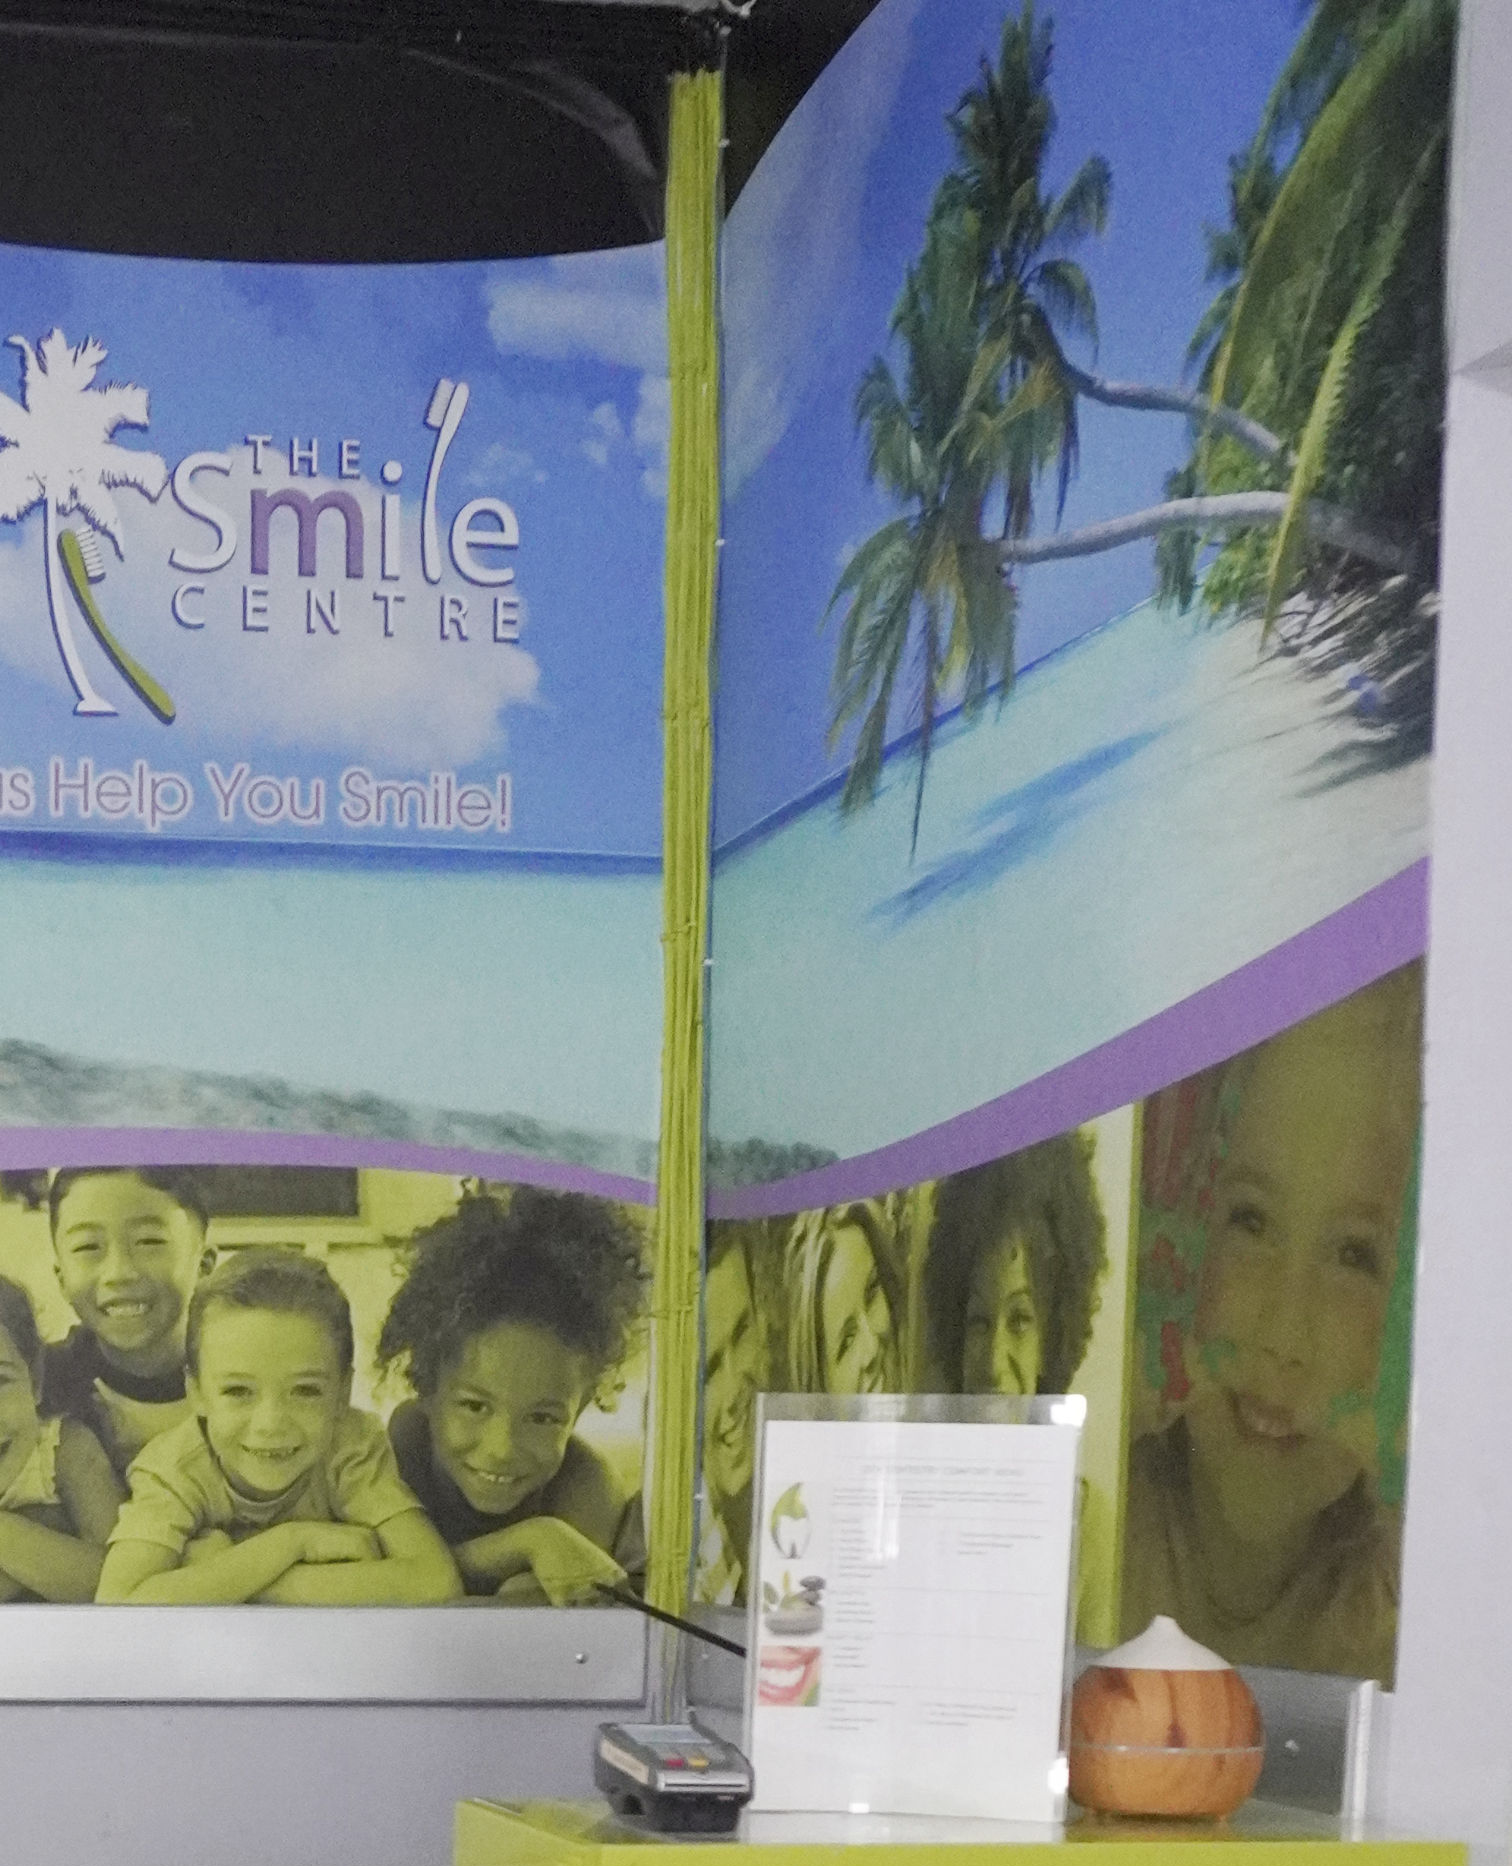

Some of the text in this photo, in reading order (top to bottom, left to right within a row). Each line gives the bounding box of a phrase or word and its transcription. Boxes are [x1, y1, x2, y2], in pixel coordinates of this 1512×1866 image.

[169, 378, 520, 588] Smile
[241, 434, 362, 480] THE
[172, 585, 522, 643] CENTRE
[50, 758, 190, 829] Help
[207, 764, 323, 825] You
[341, 770, 513, 830] Smile!
